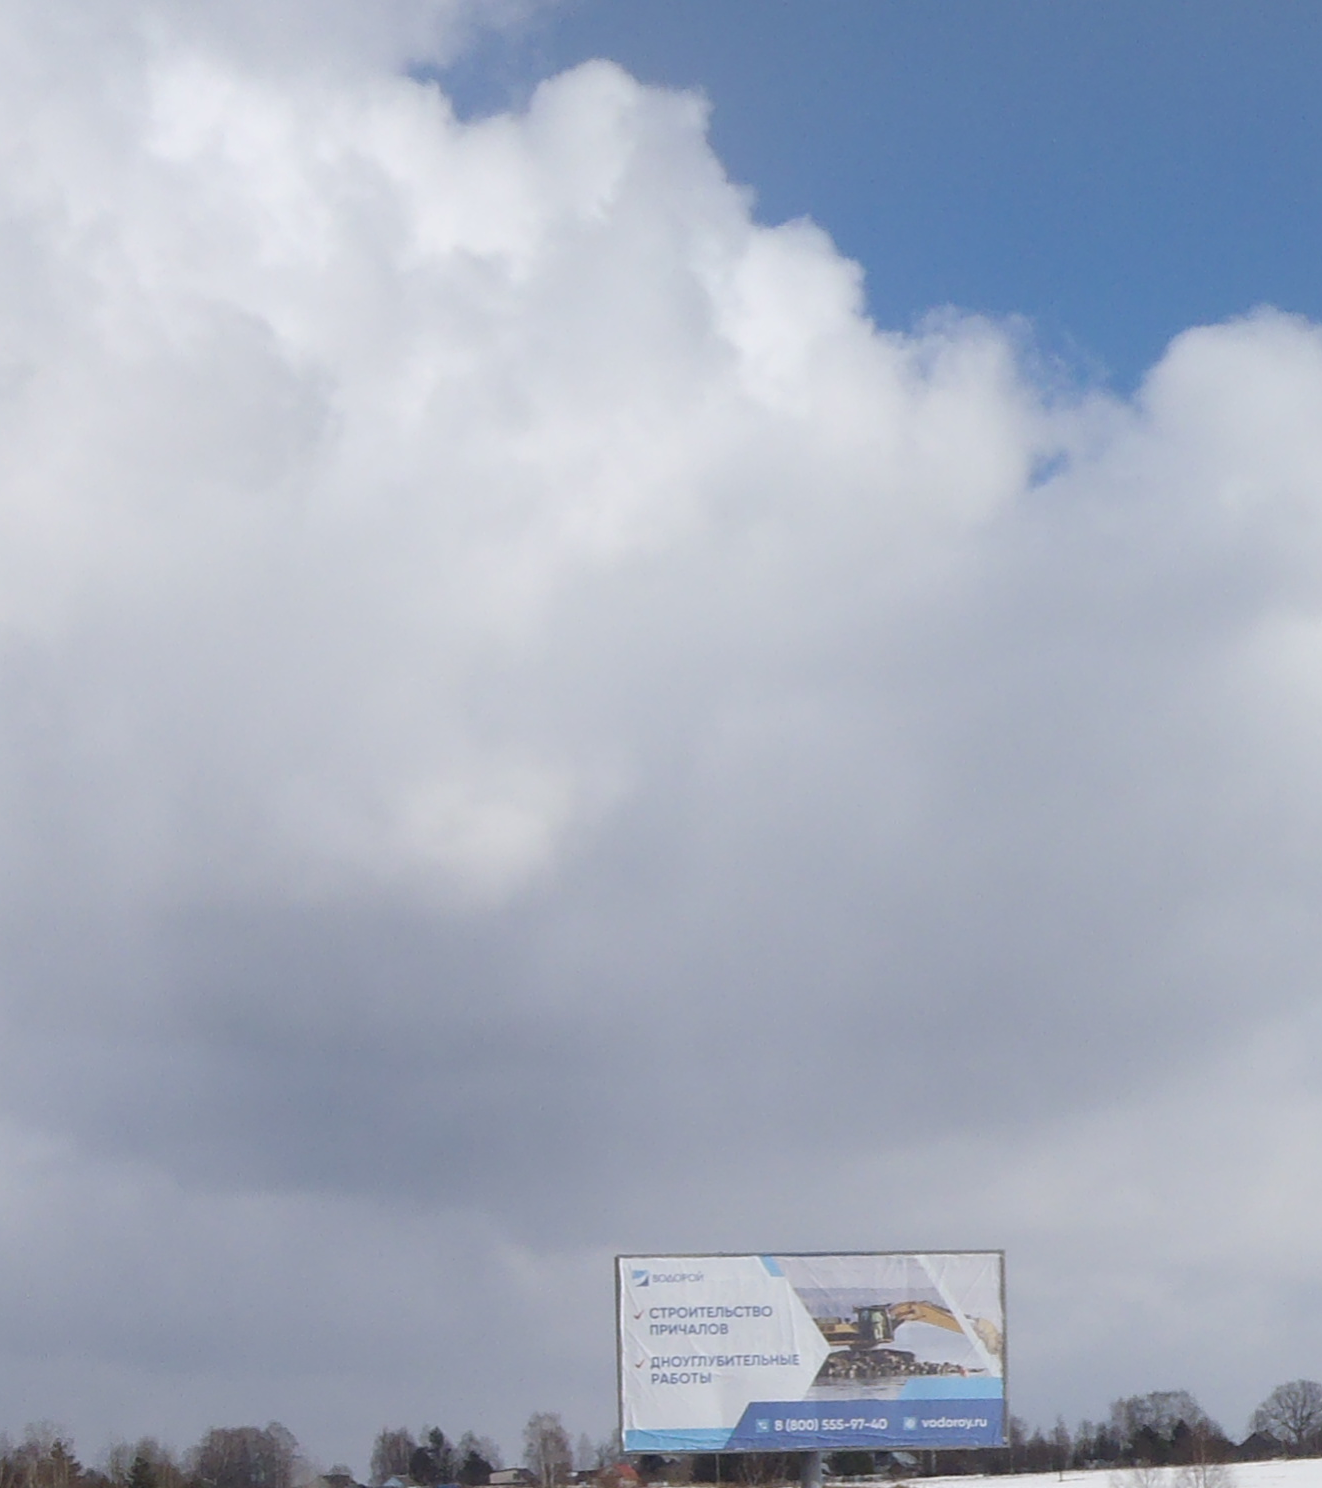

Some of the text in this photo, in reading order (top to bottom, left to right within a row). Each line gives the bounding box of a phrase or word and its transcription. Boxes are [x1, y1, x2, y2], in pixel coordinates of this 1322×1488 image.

[652, 1271, 704, 1283] ВОДОРОЙ
[649, 1306, 773, 1319] СТРОИТЕЛЬСТВО
[650, 1323, 729, 1336] ПРИЧАЛОВ
[650, 1354, 800, 1369] ДНОУГЛУБИТЕЛЬНЫЕ
[651, 1372, 712, 1385] РАБОТЫ
[774, 1418, 888, 1432] 8 (800) 555-97-40
[922, 1417, 988, 1430] vodoroy.ru
